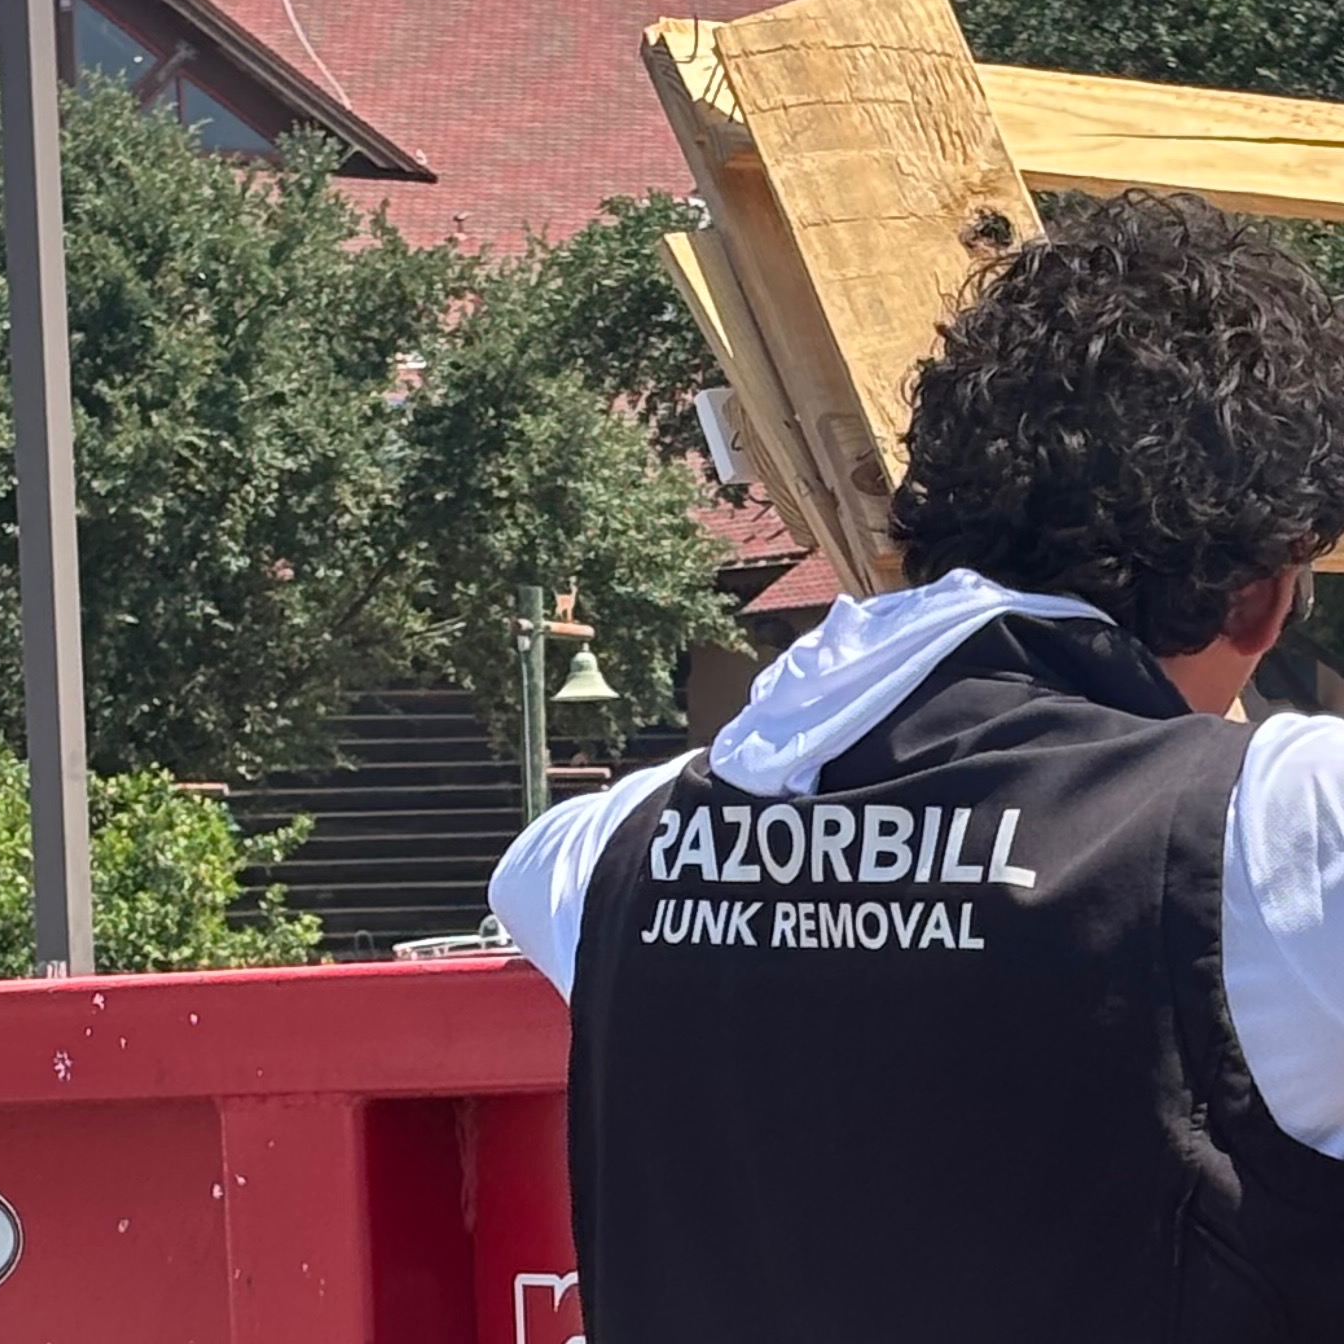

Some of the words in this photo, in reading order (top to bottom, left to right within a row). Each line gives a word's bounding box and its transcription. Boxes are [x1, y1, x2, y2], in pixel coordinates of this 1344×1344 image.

[650, 802, 1036, 889] RAZORBILL
[640, 898, 764, 947] JUNK
[770, 900, 985, 950] REMOVAL
